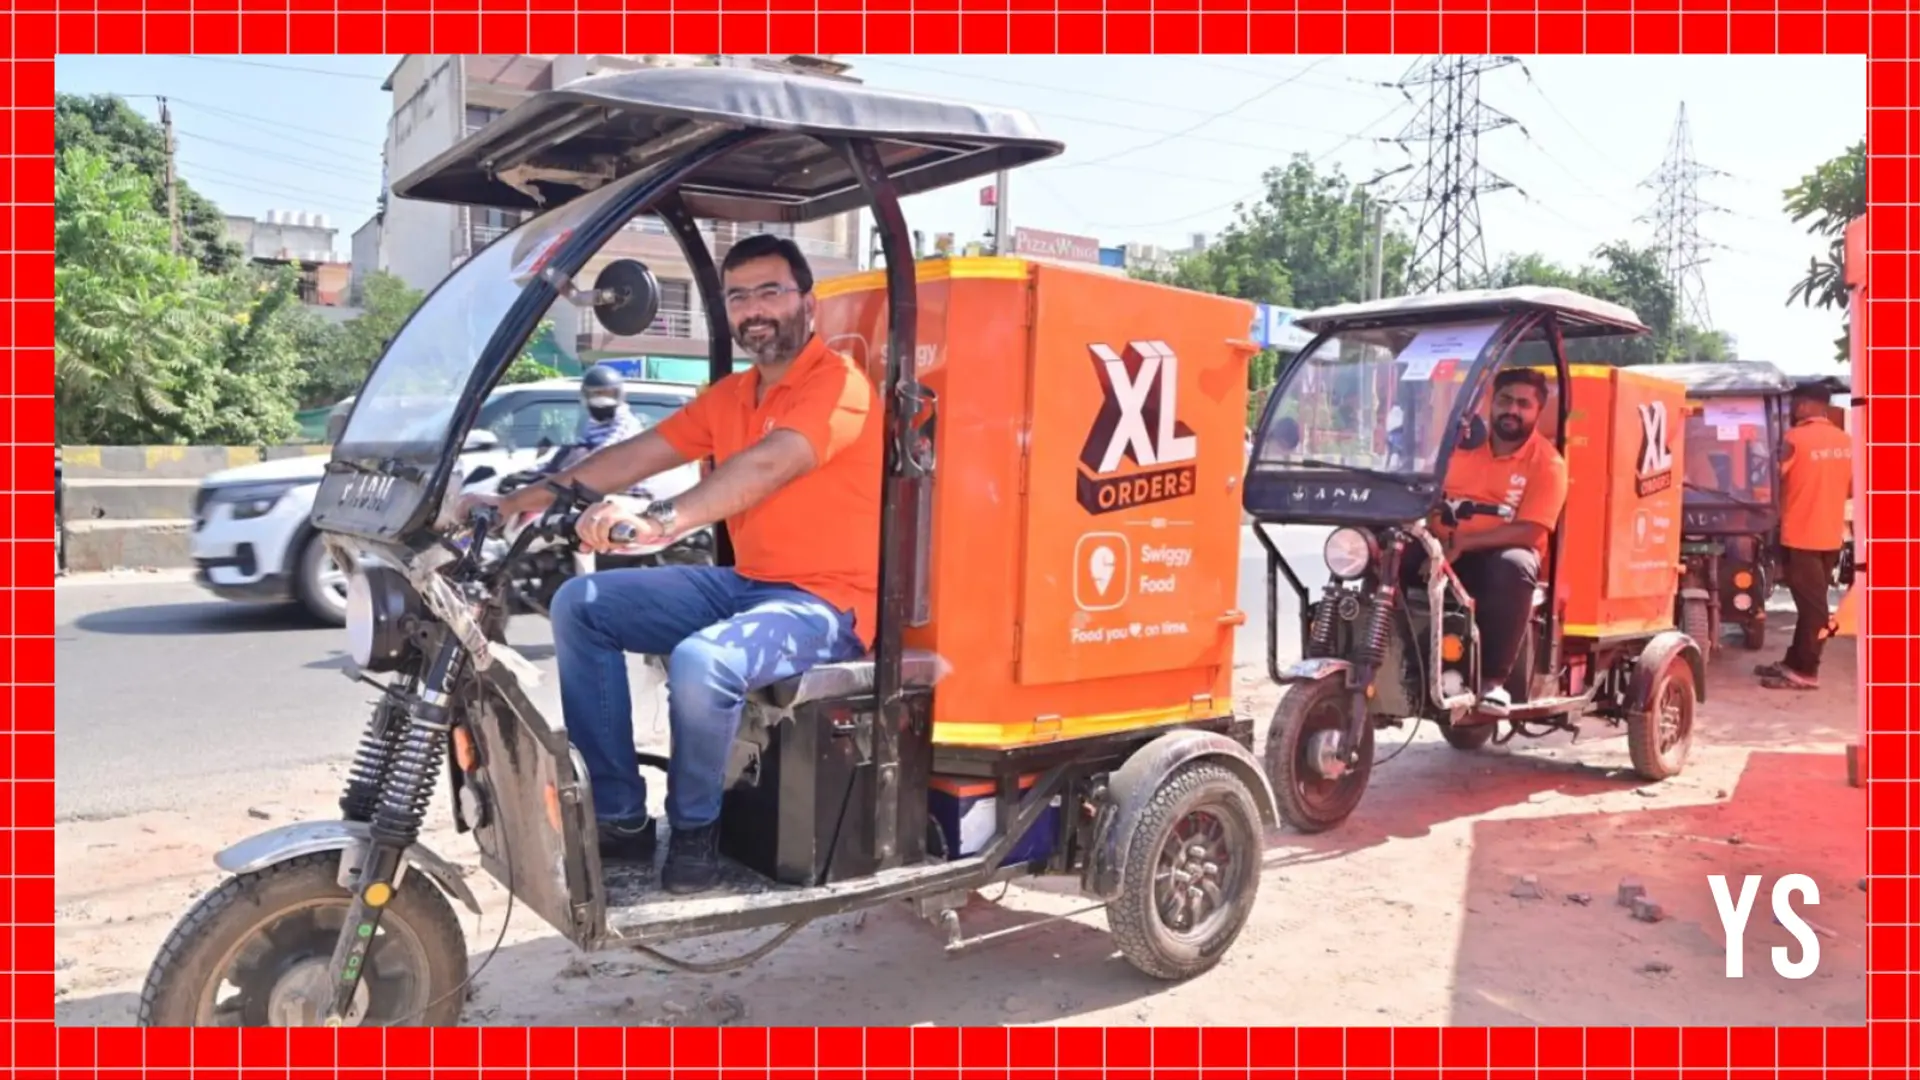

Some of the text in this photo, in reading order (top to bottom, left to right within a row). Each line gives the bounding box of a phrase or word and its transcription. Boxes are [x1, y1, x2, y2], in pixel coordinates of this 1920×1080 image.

[1080, 340, 1197, 474] XL
[1637, 401, 1673, 475] XL
[1098, 470, 1192, 509] ORDERS
[1140, 544, 1192, 568] Swiggy
[1139, 573, 1176, 593] Food
[1071, 627, 1104, 644] Food
[1105, 627, 1129, 644] you
